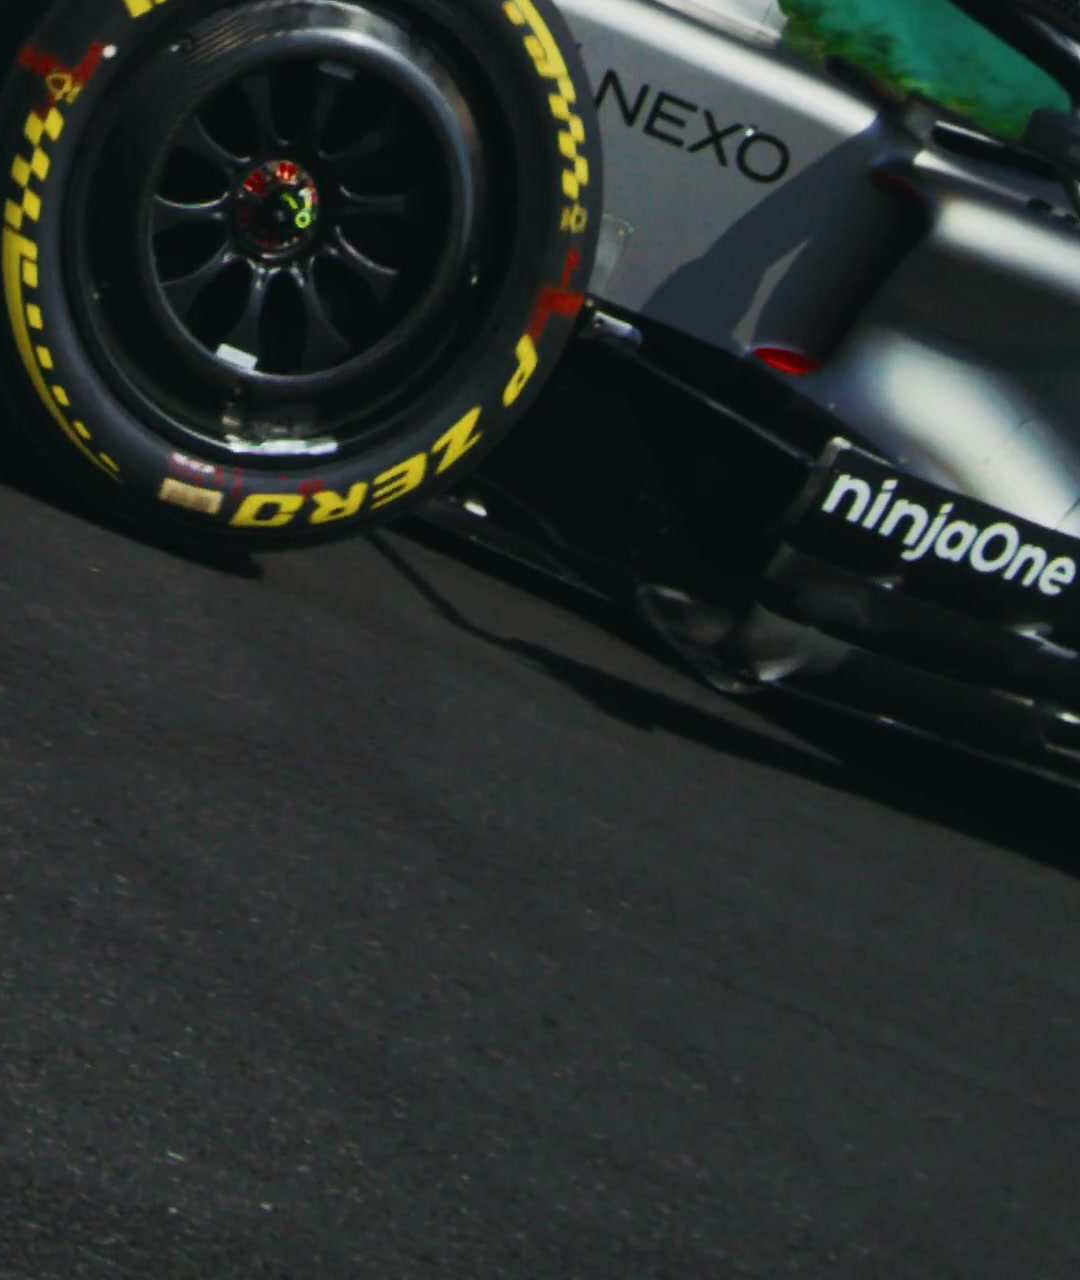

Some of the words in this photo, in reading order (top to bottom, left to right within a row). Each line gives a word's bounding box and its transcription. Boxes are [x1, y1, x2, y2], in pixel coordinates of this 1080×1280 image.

[594, 69, 791, 184] NEXO
[502, 333, 538, 407] P
[229, 406, 482, 527] ZERO
[821, 473, 1077, 596] ninjaOne
